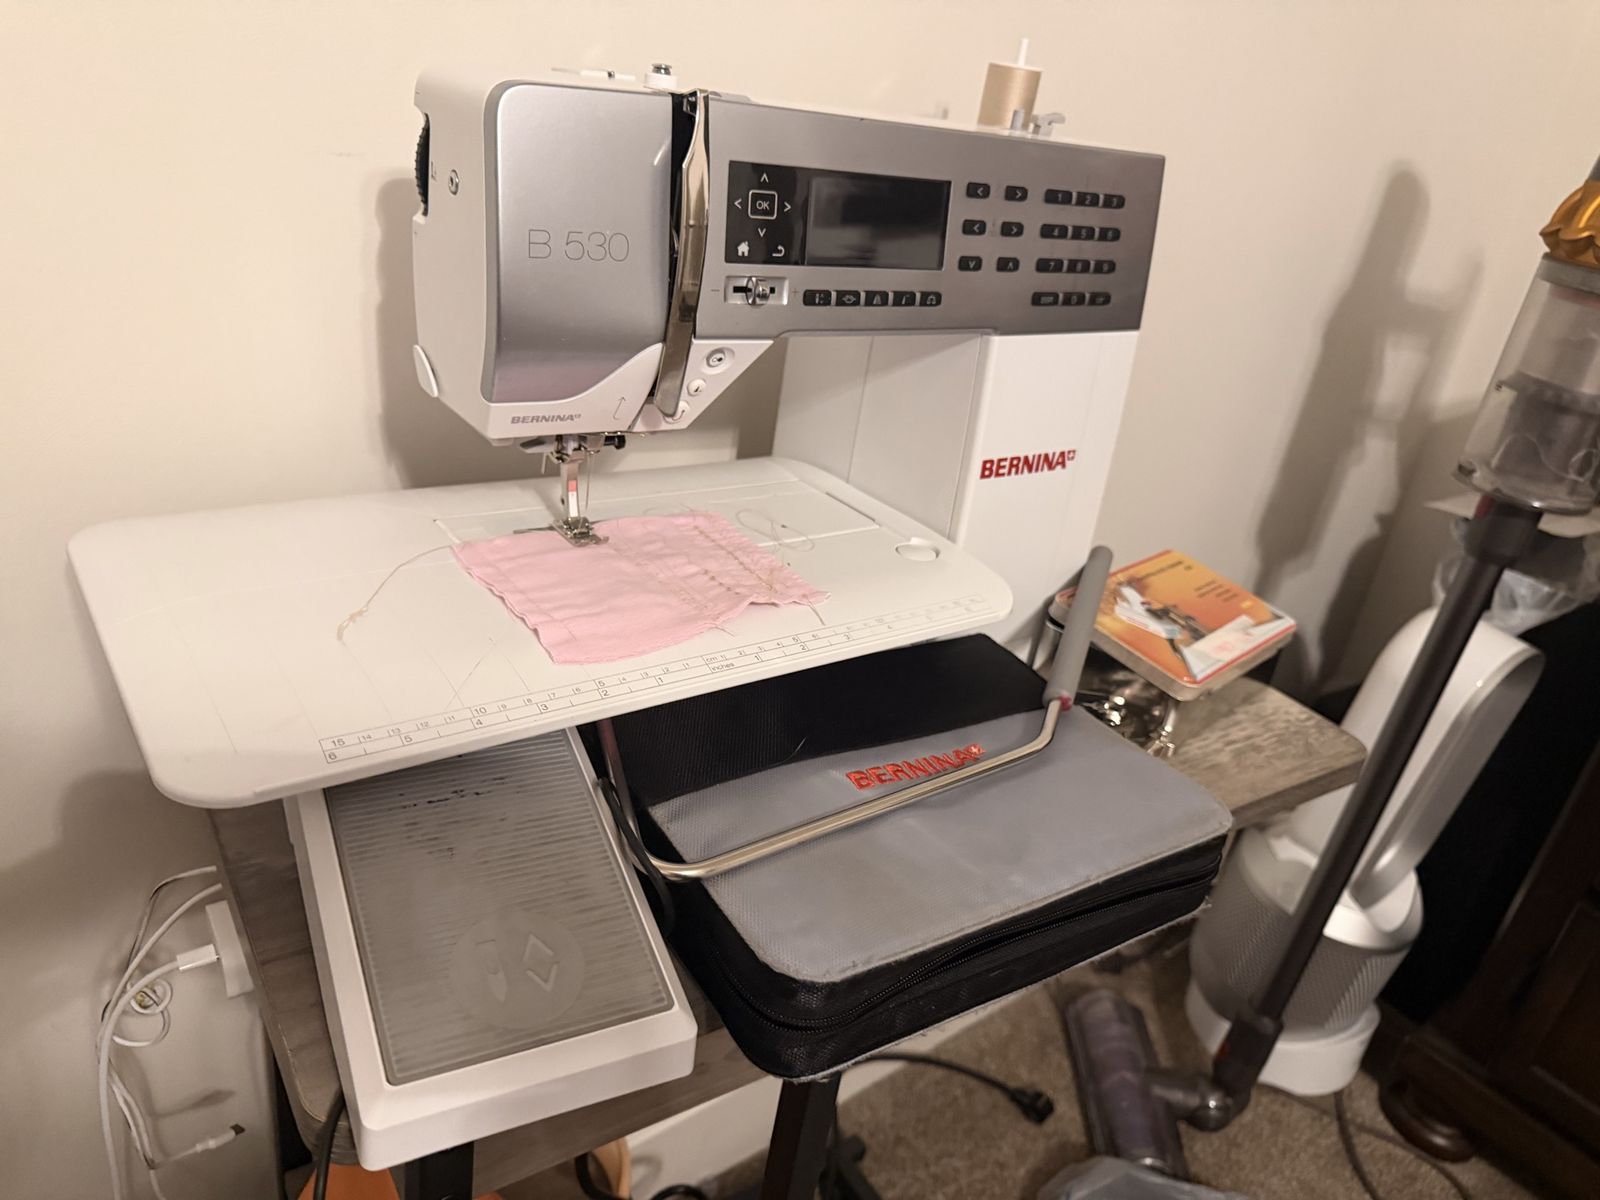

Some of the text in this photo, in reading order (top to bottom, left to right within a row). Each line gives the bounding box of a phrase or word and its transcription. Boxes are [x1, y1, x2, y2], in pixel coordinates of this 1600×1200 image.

[756, 200, 770, 211] OK
[528, 229, 630, 262] B 530
[510, 413, 575, 425] BERNINA
[979, 450, 1067, 480] BERNINA
[706, 655, 718, 664] cm
[711, 662, 735, 672] inches
[328, 752, 337, 761] 6
[404, 735, 413, 743] 5
[475, 718, 484, 727] 4
[541, 703, 549, 711] 3
[601, 689, 609, 697] 2
[331, 738, 346, 748] 15
[419, 721, 430, 729] 12
[474, 706, 487, 715] 10
[598, 679, 606, 687] 5
[845, 747, 972, 791] BERNINA
